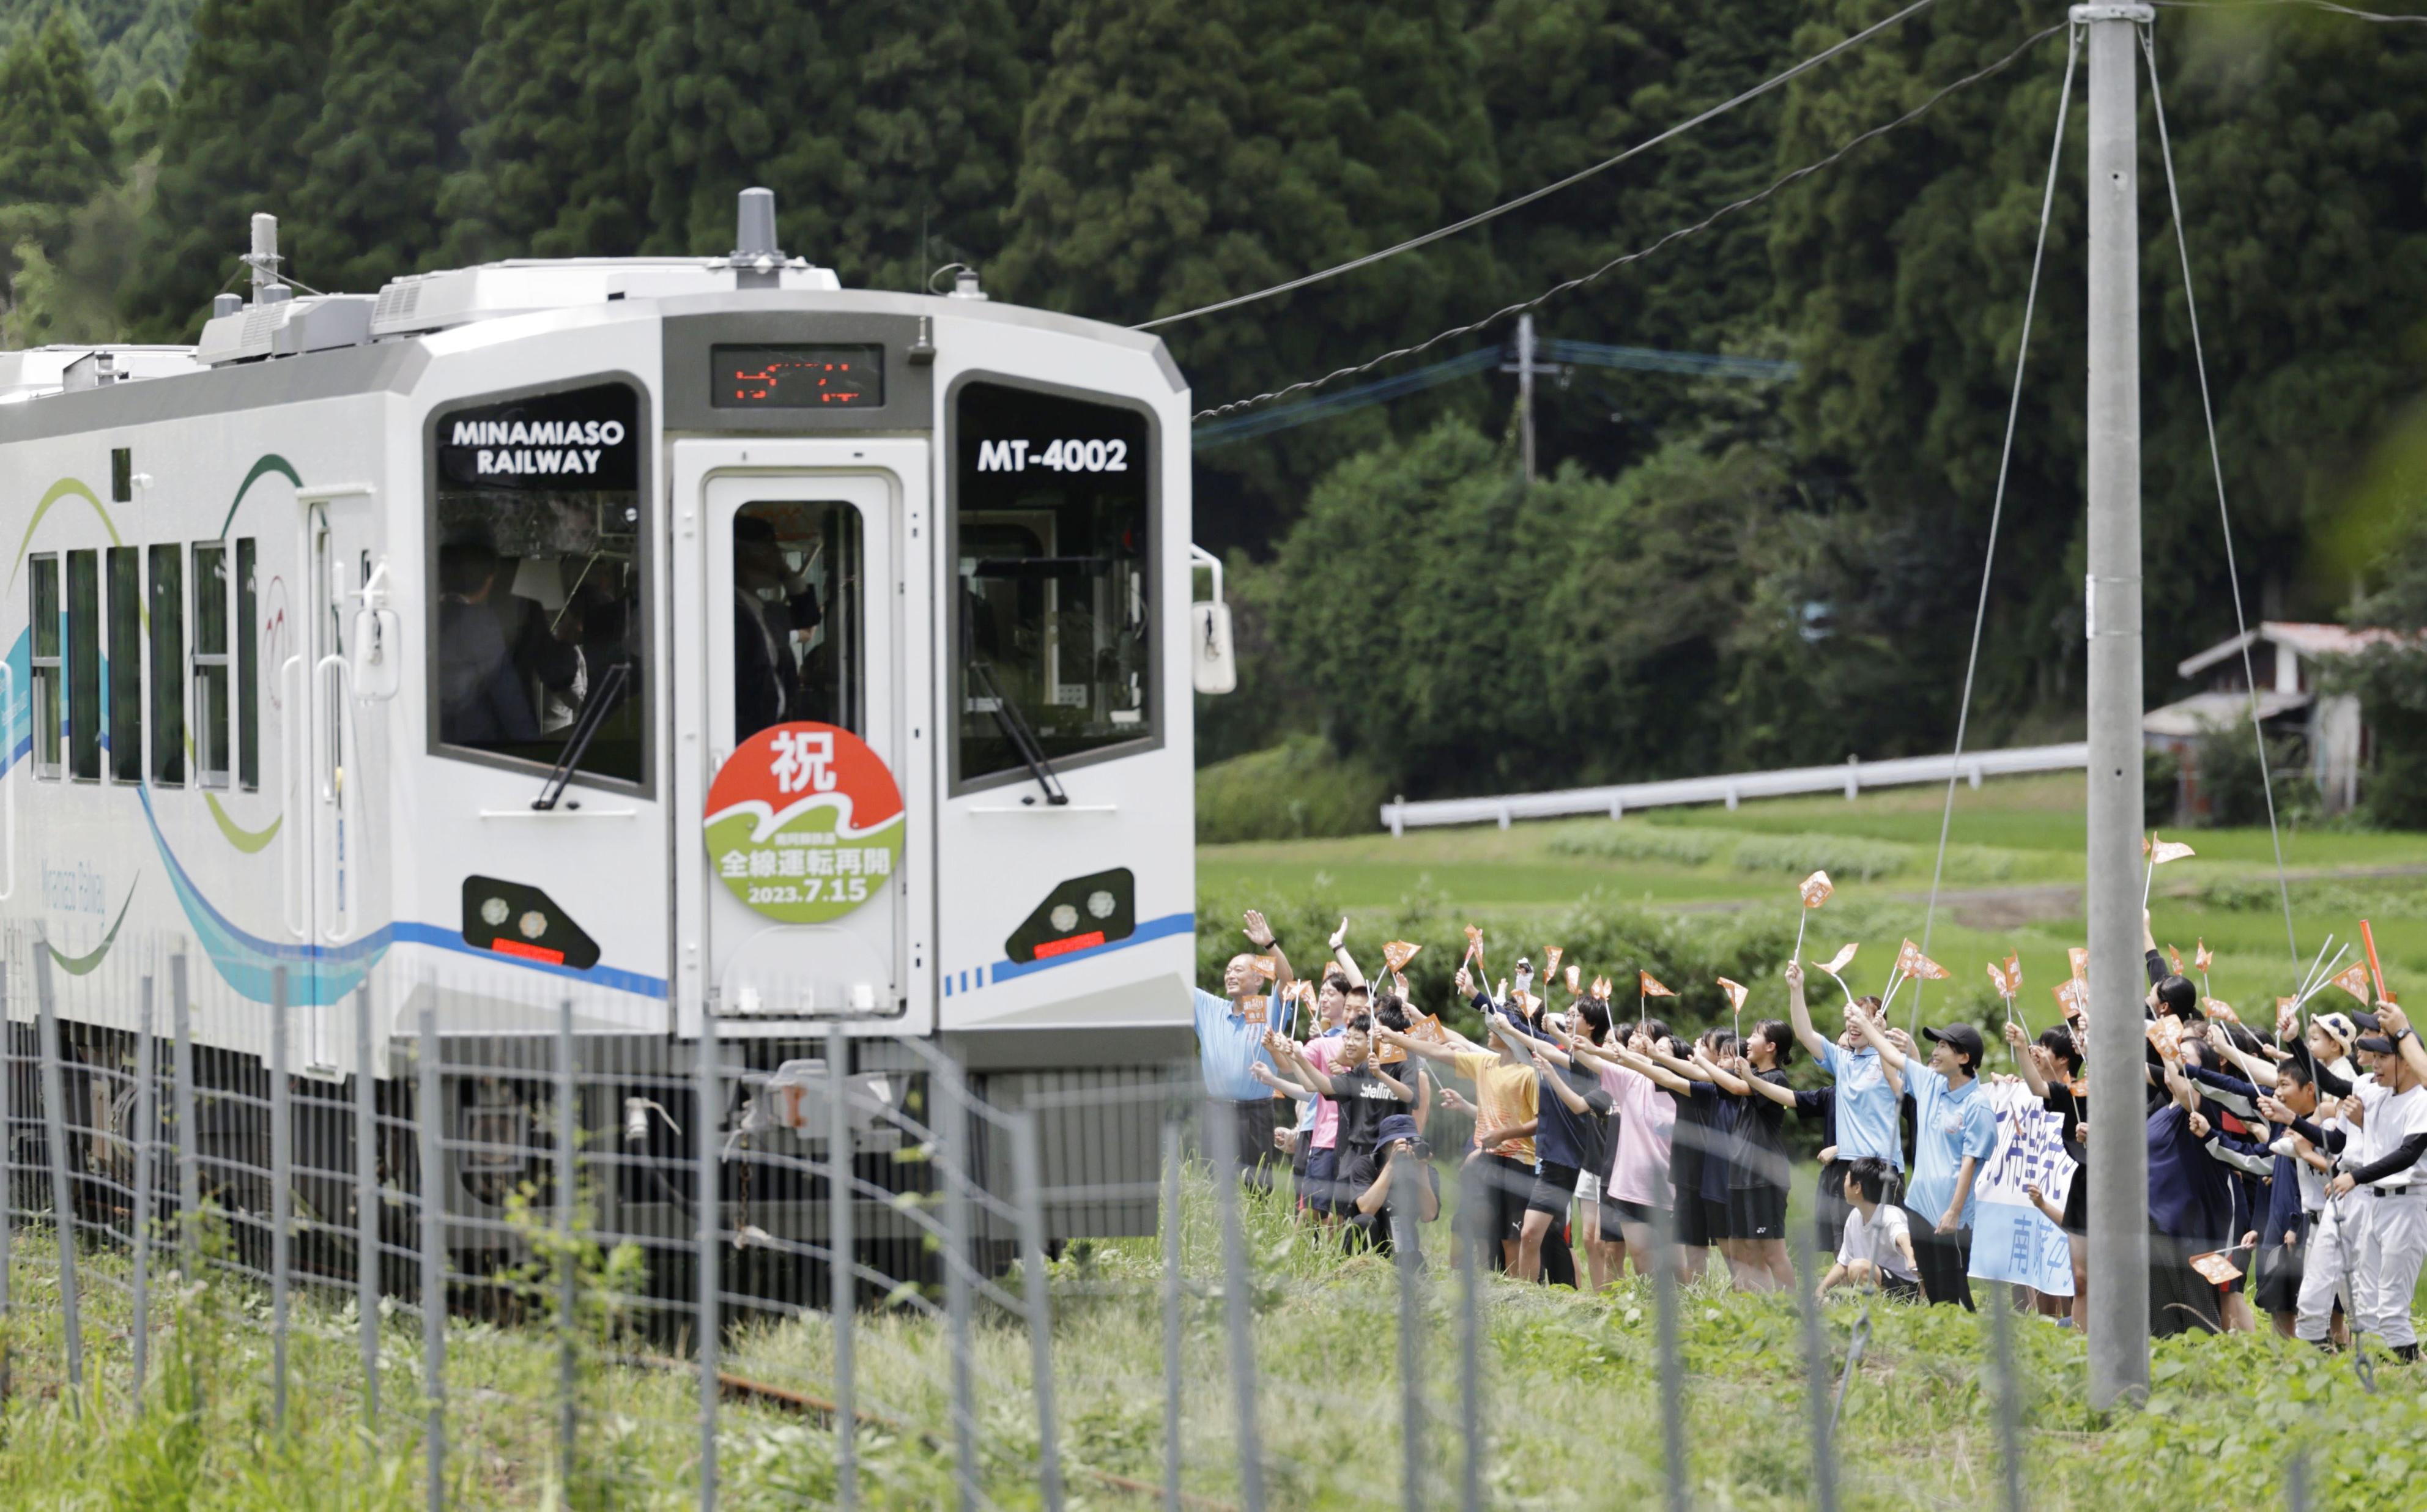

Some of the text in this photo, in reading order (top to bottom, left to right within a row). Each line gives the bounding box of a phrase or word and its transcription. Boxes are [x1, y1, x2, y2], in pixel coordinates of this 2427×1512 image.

[452, 420, 624, 445] MINAMIASO
[477, 449, 601, 474] RAILWAY
[977, 439, 1127, 472] MT-4002
[770, 730, 837, 793] 祝
[720, 847, 891, 877] 全線運転再開
[747, 878, 867, 904] 2023.7.15
